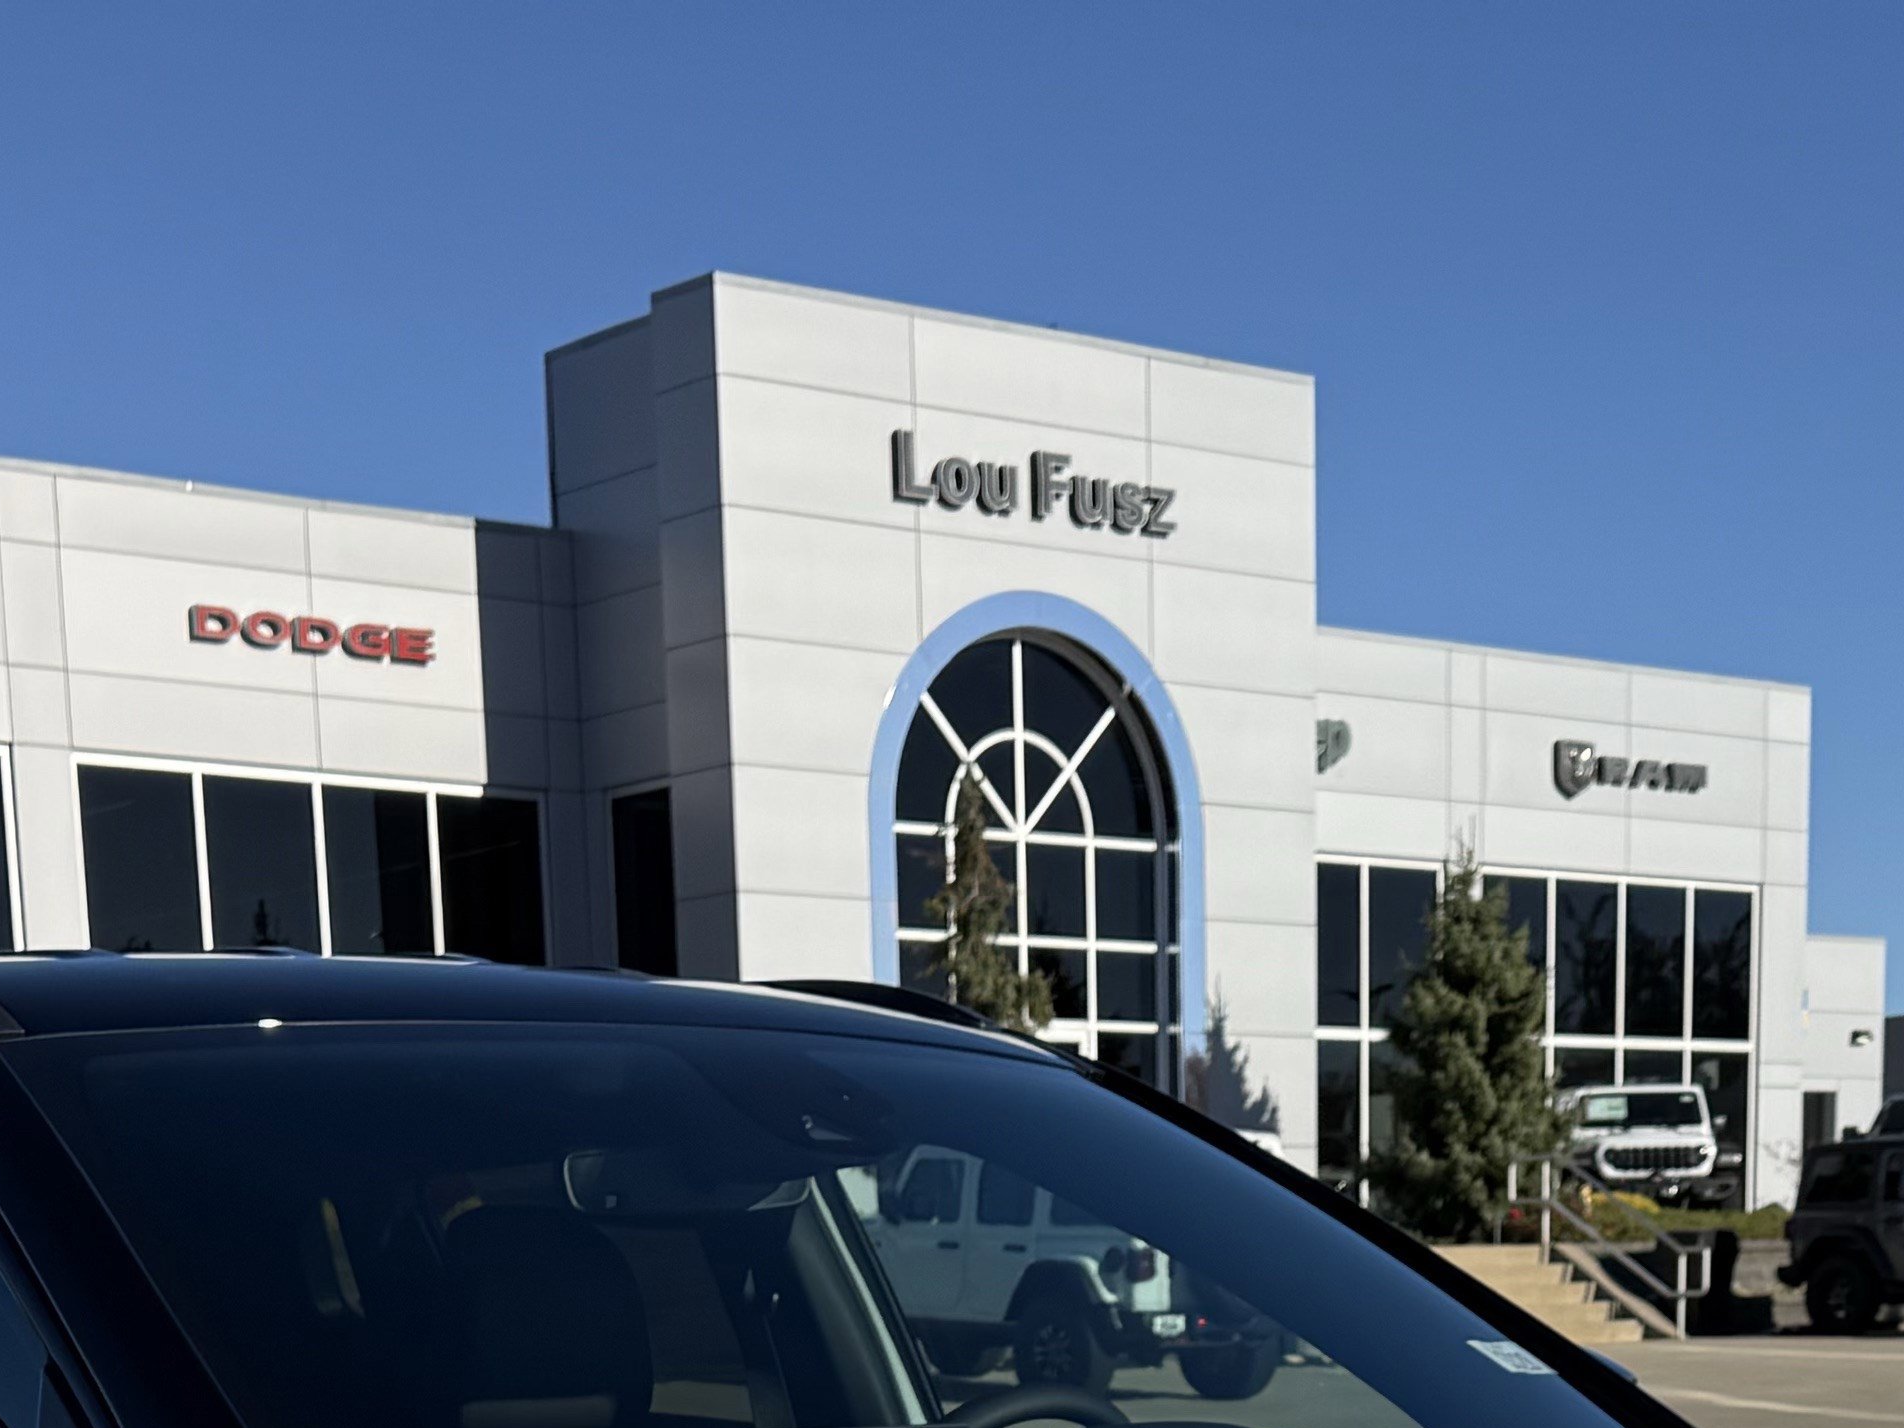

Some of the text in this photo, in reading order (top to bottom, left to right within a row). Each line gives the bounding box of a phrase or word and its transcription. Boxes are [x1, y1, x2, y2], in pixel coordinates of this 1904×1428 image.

[891, 429, 1177, 539] Lou Fusz
[188, 604, 436, 668] DODGE
